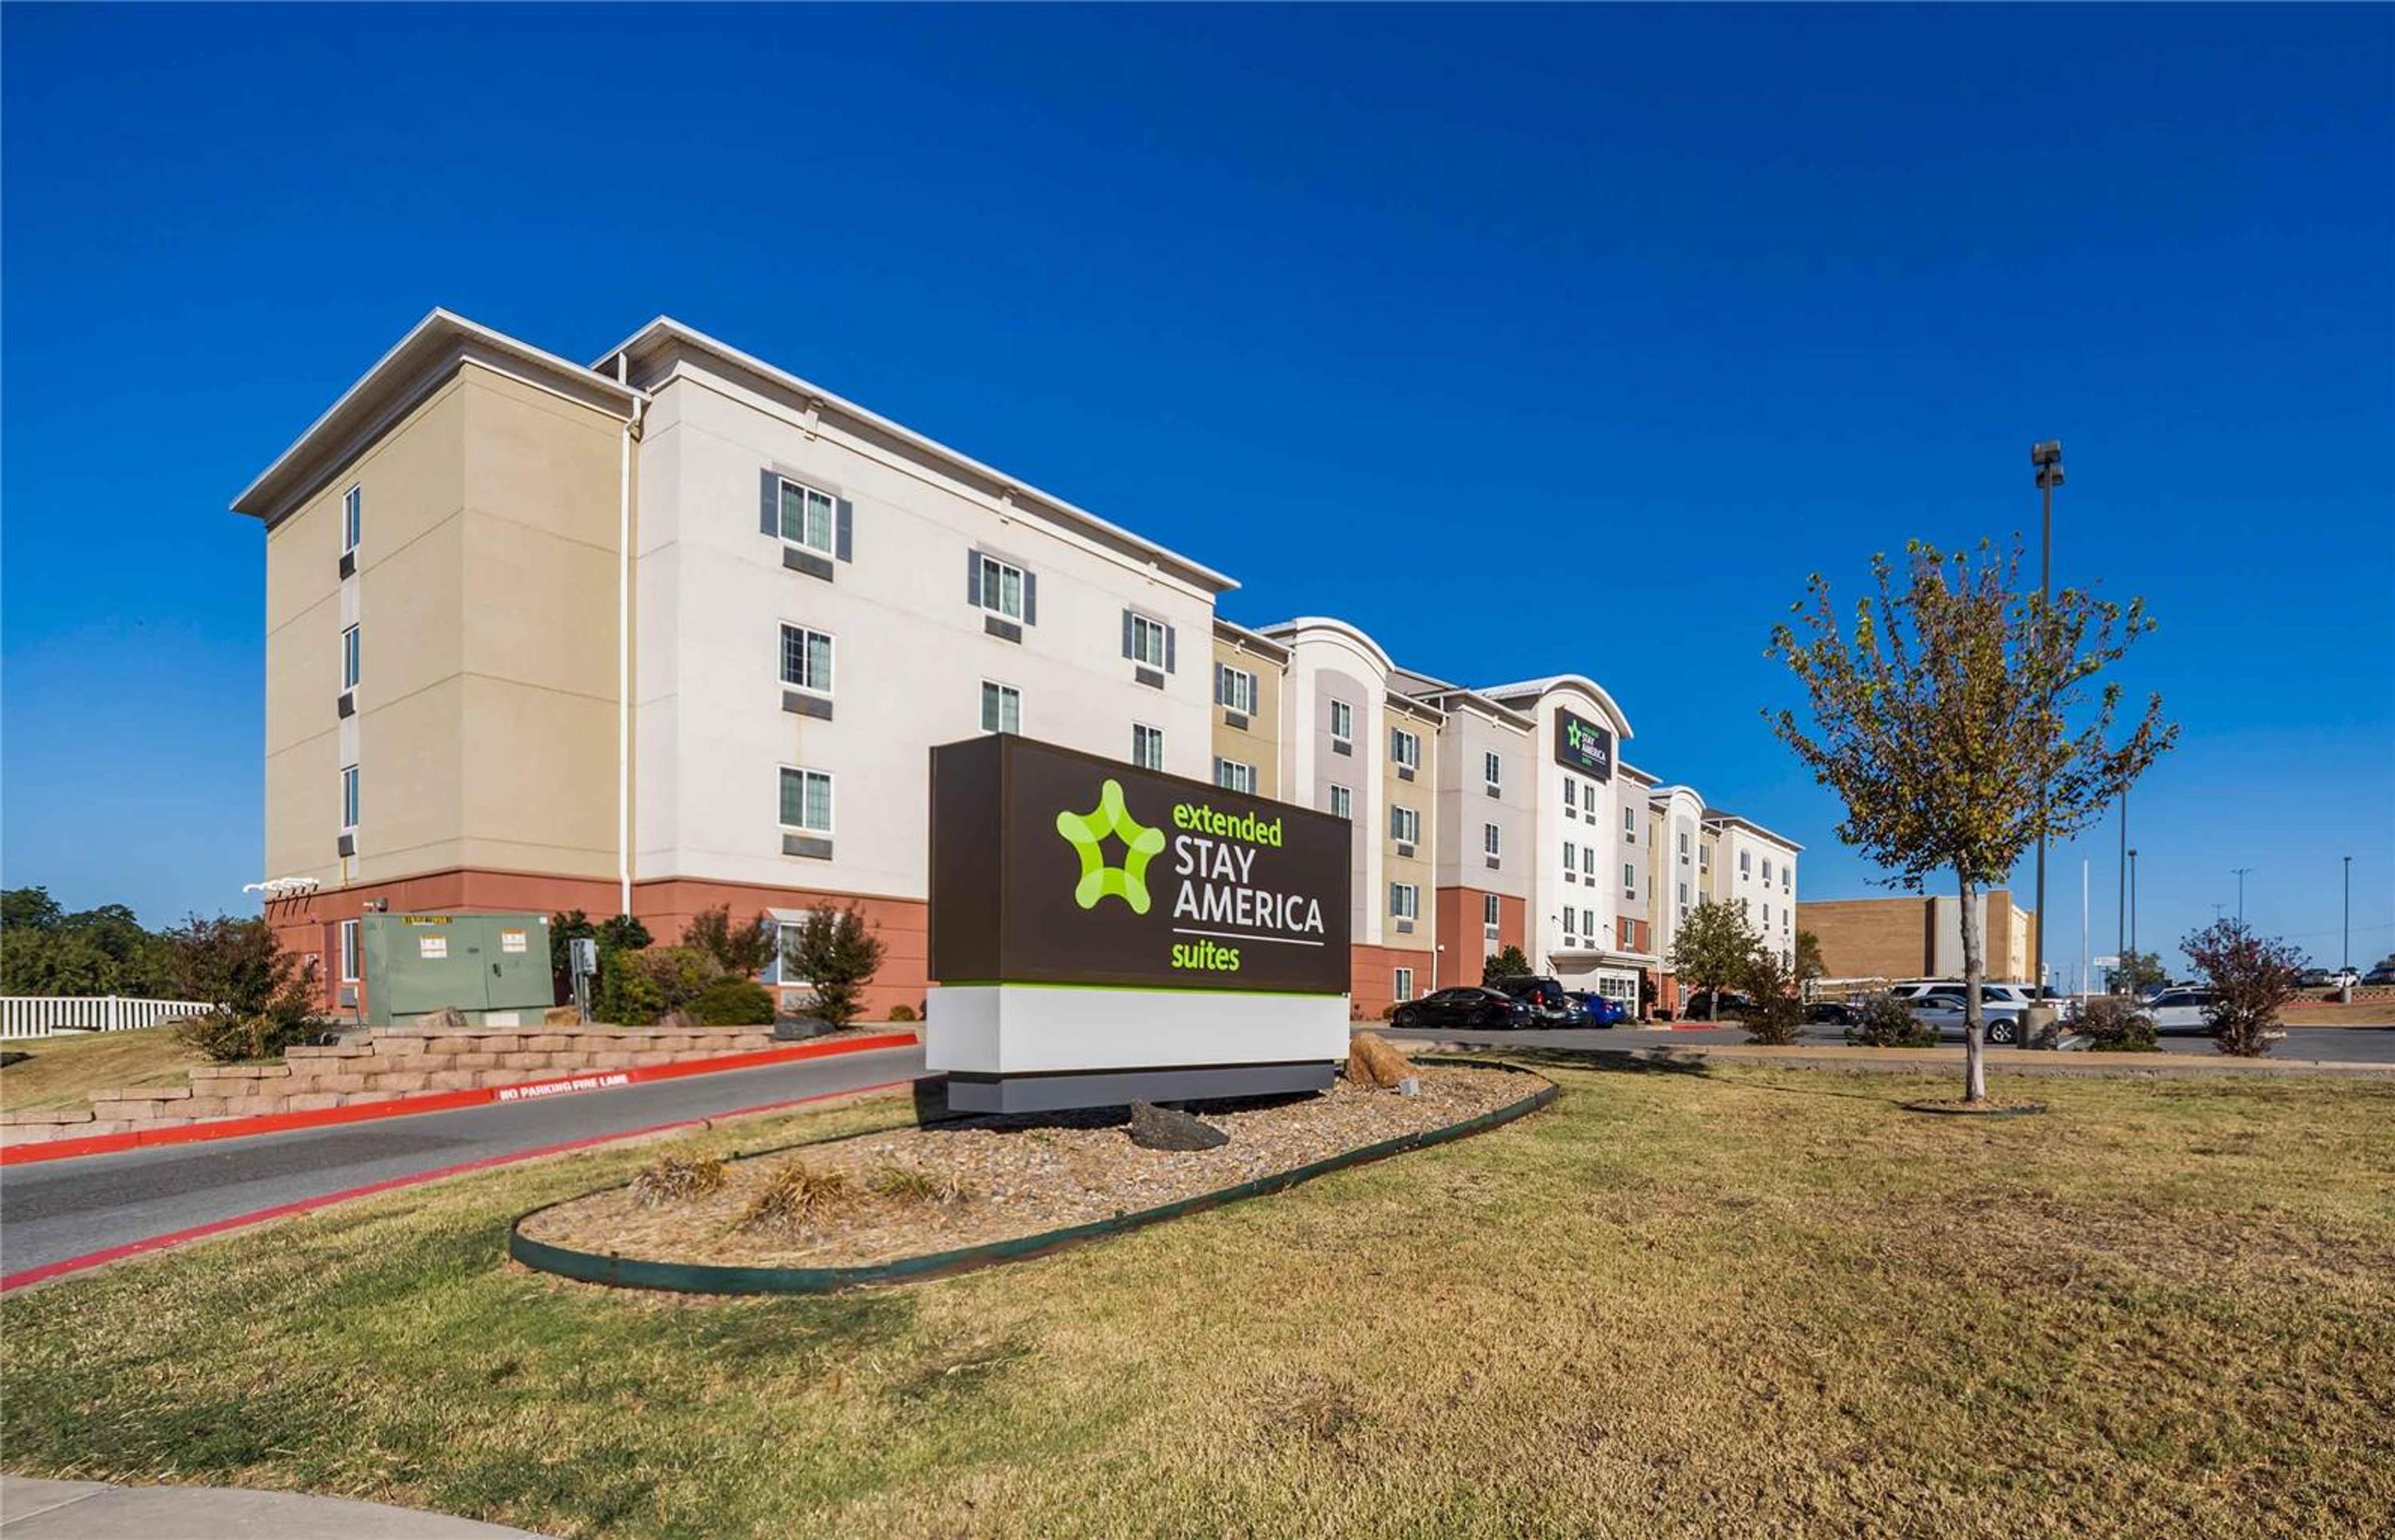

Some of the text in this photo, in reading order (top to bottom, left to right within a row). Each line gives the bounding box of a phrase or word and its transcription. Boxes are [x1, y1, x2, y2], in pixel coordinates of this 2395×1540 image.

[1173, 803, 1282, 848] extended
[1174, 835, 1256, 884] STAY
[1173, 880, 1325, 934] AMERICA
[1171, 939, 1240, 971] suites
[500, 1074, 627, 1100] NO PARKING FIRE LANE
